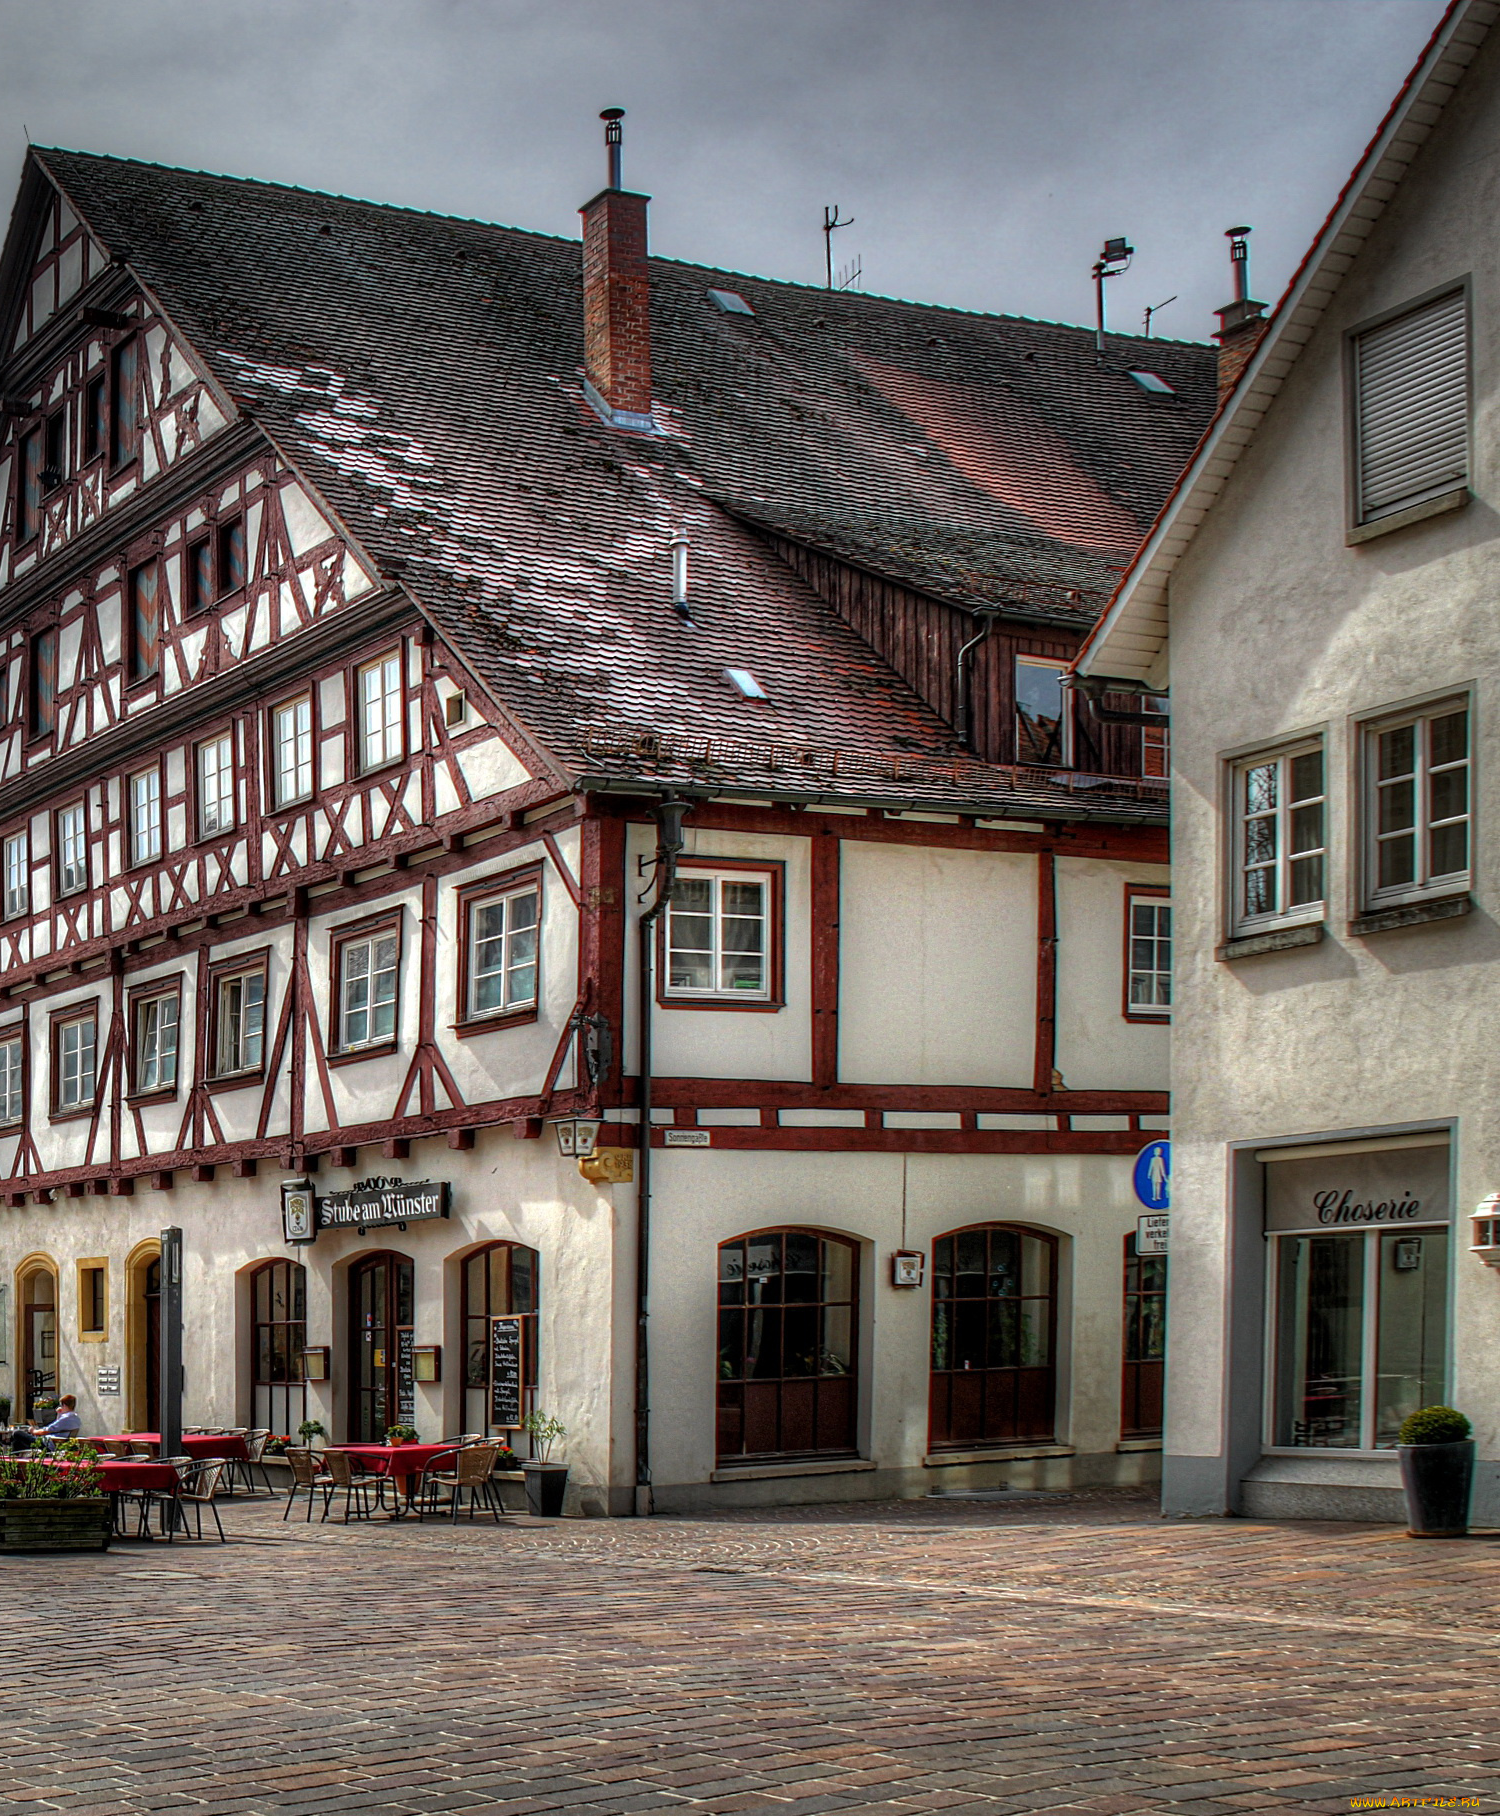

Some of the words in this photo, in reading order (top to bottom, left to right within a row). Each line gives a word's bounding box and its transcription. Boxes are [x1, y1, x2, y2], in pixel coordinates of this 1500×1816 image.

[321, 1196, 360, 1225] Stube
[362, 1201, 381, 1220] am
[381, 1192, 439, 1219] Münster
[1314, 1189, 1419, 1224] Choserie
